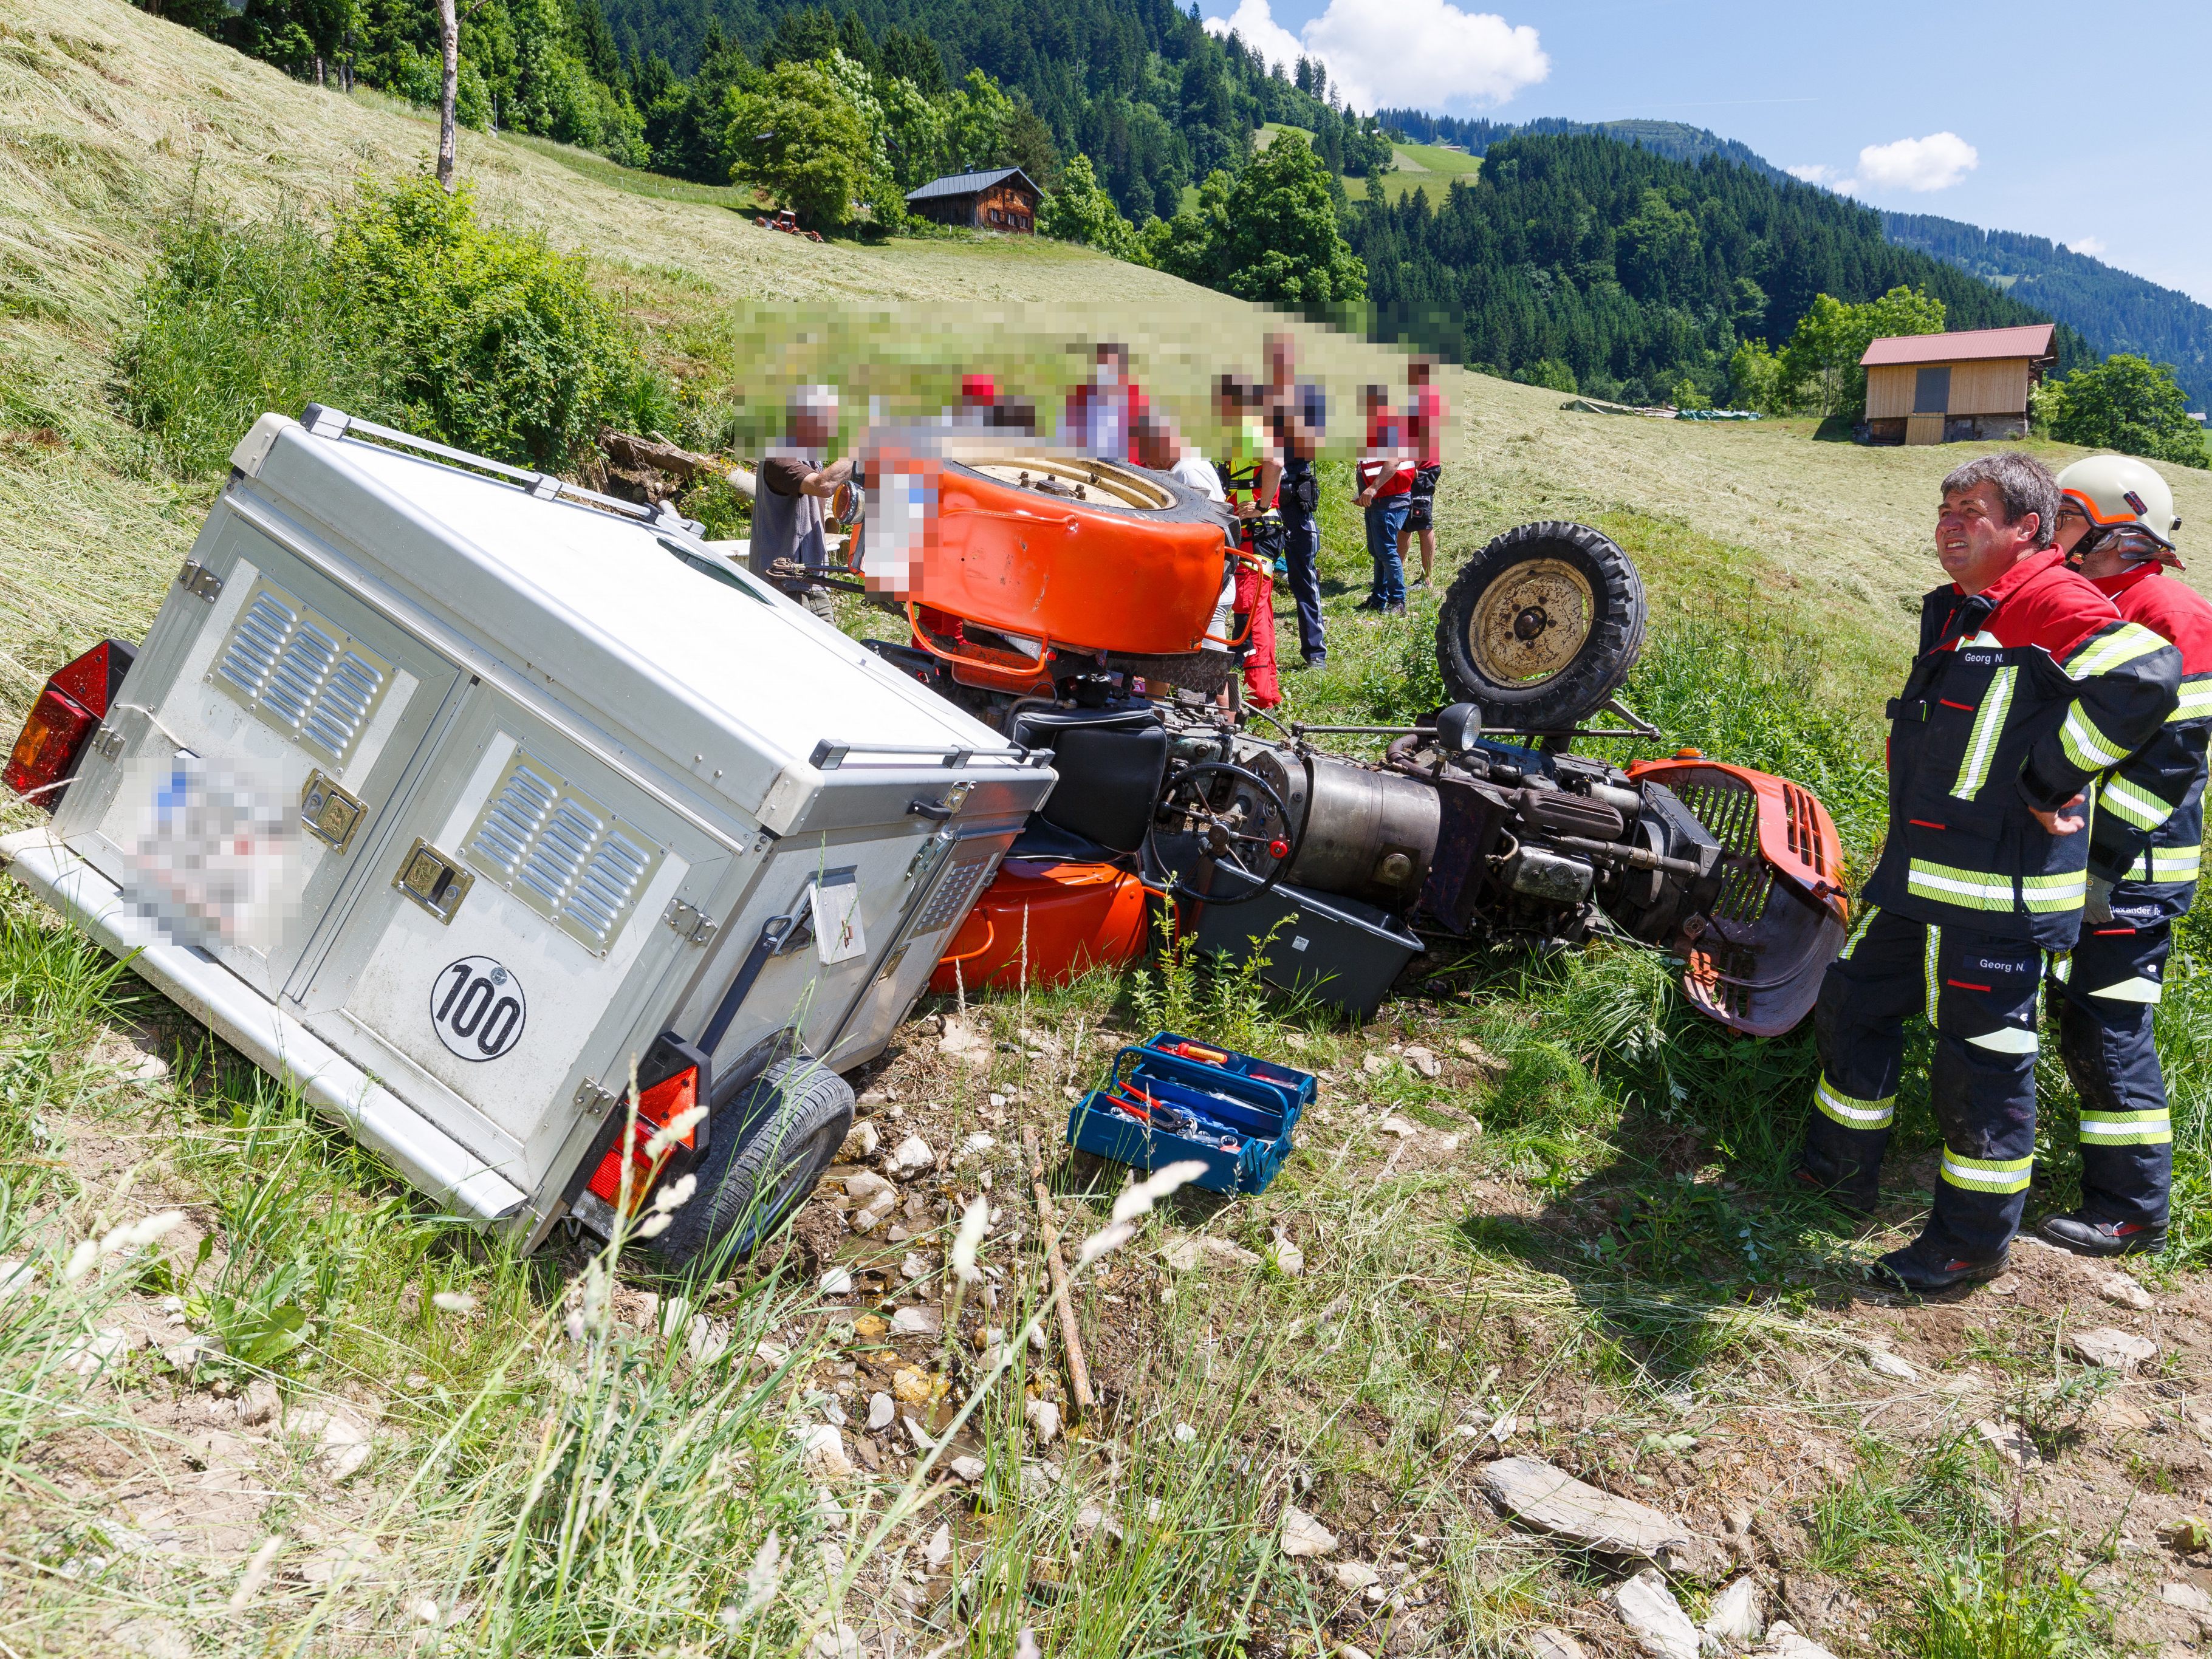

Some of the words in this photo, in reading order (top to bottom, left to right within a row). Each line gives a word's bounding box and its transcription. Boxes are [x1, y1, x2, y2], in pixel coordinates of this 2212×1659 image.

[1965, 652, 1991, 665] Georg
[1995, 654, 2004, 663] N.
[1979, 959, 2012, 973] Georg
[2016, 963, 2025, 971] N.
[436, 964, 521, 1056] 100
